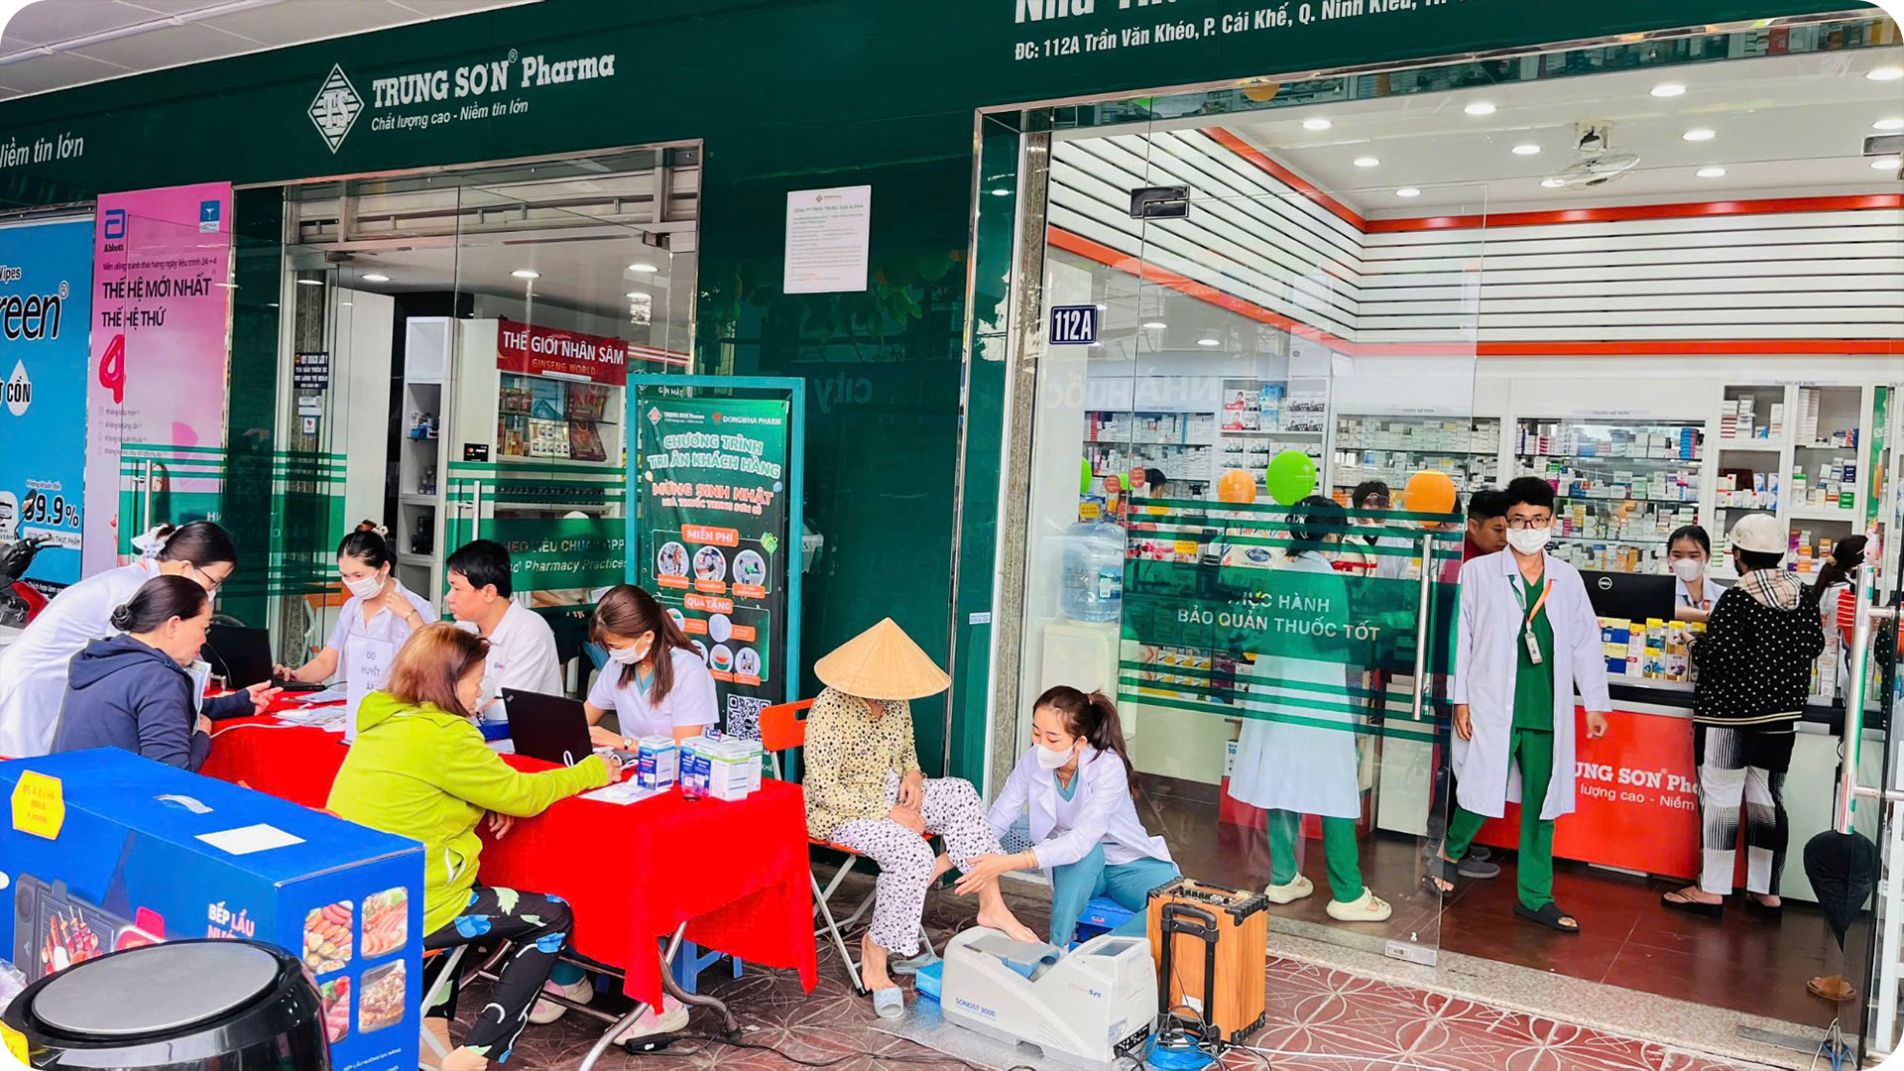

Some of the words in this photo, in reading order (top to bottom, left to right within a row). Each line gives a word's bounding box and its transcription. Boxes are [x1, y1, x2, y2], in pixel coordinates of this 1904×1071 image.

[1015, 43, 1039, 60] ĐC:
[1043, 36, 1080, 57] 112A
[1085, 28, 1117, 51] Trần
[1122, 27, 1150, 47] Văn
[1154, 20, 1199, 43] Khéo,
[1204, 17, 1215, 36] P.
[1222, 11, 1249, 33] Cái
[1254, 1, 1293, 28] Khế,
[1299, 4, 1316, 25] Q.
[1321, 0, 1363, 20] Ninh
[372, 69, 449, 108] TRUNG
[521, 53, 615, 88] Pharma
[371, 113, 394, 131] Chất
[397, 112, 427, 131] lượng
[430, 112, 450, 123] cao
[460, 101, 489, 121] Niềm
[492, 102, 506, 116] tin
[509, 97, 528, 114] lớn
[0, 136, 29, 168] iềm
[34, 137, 53, 163] tin
[56, 132, 84, 160] lớn
[103, 244, 124, 253] Abbott
[103, 276, 127, 300] THẾ
[127, 276, 144, 302] HỆ
[145, 275, 172, 298] MỚI
[173, 272, 212, 297] NHẤT
[101, 306, 123, 328] THẾ
[125, 307, 139, 331] HỆ
[141, 306, 166, 327] THỨ
[1054, 310, 1093, 342] 112A
[503, 328, 531, 351] THẾ
[531, 335, 558, 355] GIỚI
[561, 340, 596, 361] NHÂN
[599, 345, 624, 365] SÂM
[99, 334, 126, 404] 4
[531, 358, 567, 372] GINSENG
[569, 364, 597, 376] WORLD
[7, 377, 31, 403] CỒN
[664, 431, 719, 449] CHƯƠNG
[721, 433, 764, 456] TRÌNH
[647, 454, 669, 469] TRI
[669, 450, 690, 467] ÂN
[691, 450, 740, 470] KHÁCH
[740, 456, 781, 479] HÀNG
[696, 483, 730, 499] SINH
[687, 526, 714, 540] MIỄN
[715, 531, 733, 543] PHÍ
[525, 560, 580, 573] Pharmacy
[686, 598, 705, 608] QUÀ
[704, 600, 731, 612] TẶNG
[1278, 592, 1330, 613] HÀNH
[1178, 604, 1214, 625] BẢO
[1218, 609, 1268, 631] QUẢN
[1274, 616, 1337, 637] THUỐC
[1343, 620, 1380, 641] TỐT
[1580, 783, 1616, 801] lượng
[1620, 791, 1645, 803] cao
[208, 901, 230, 925] BẾP
